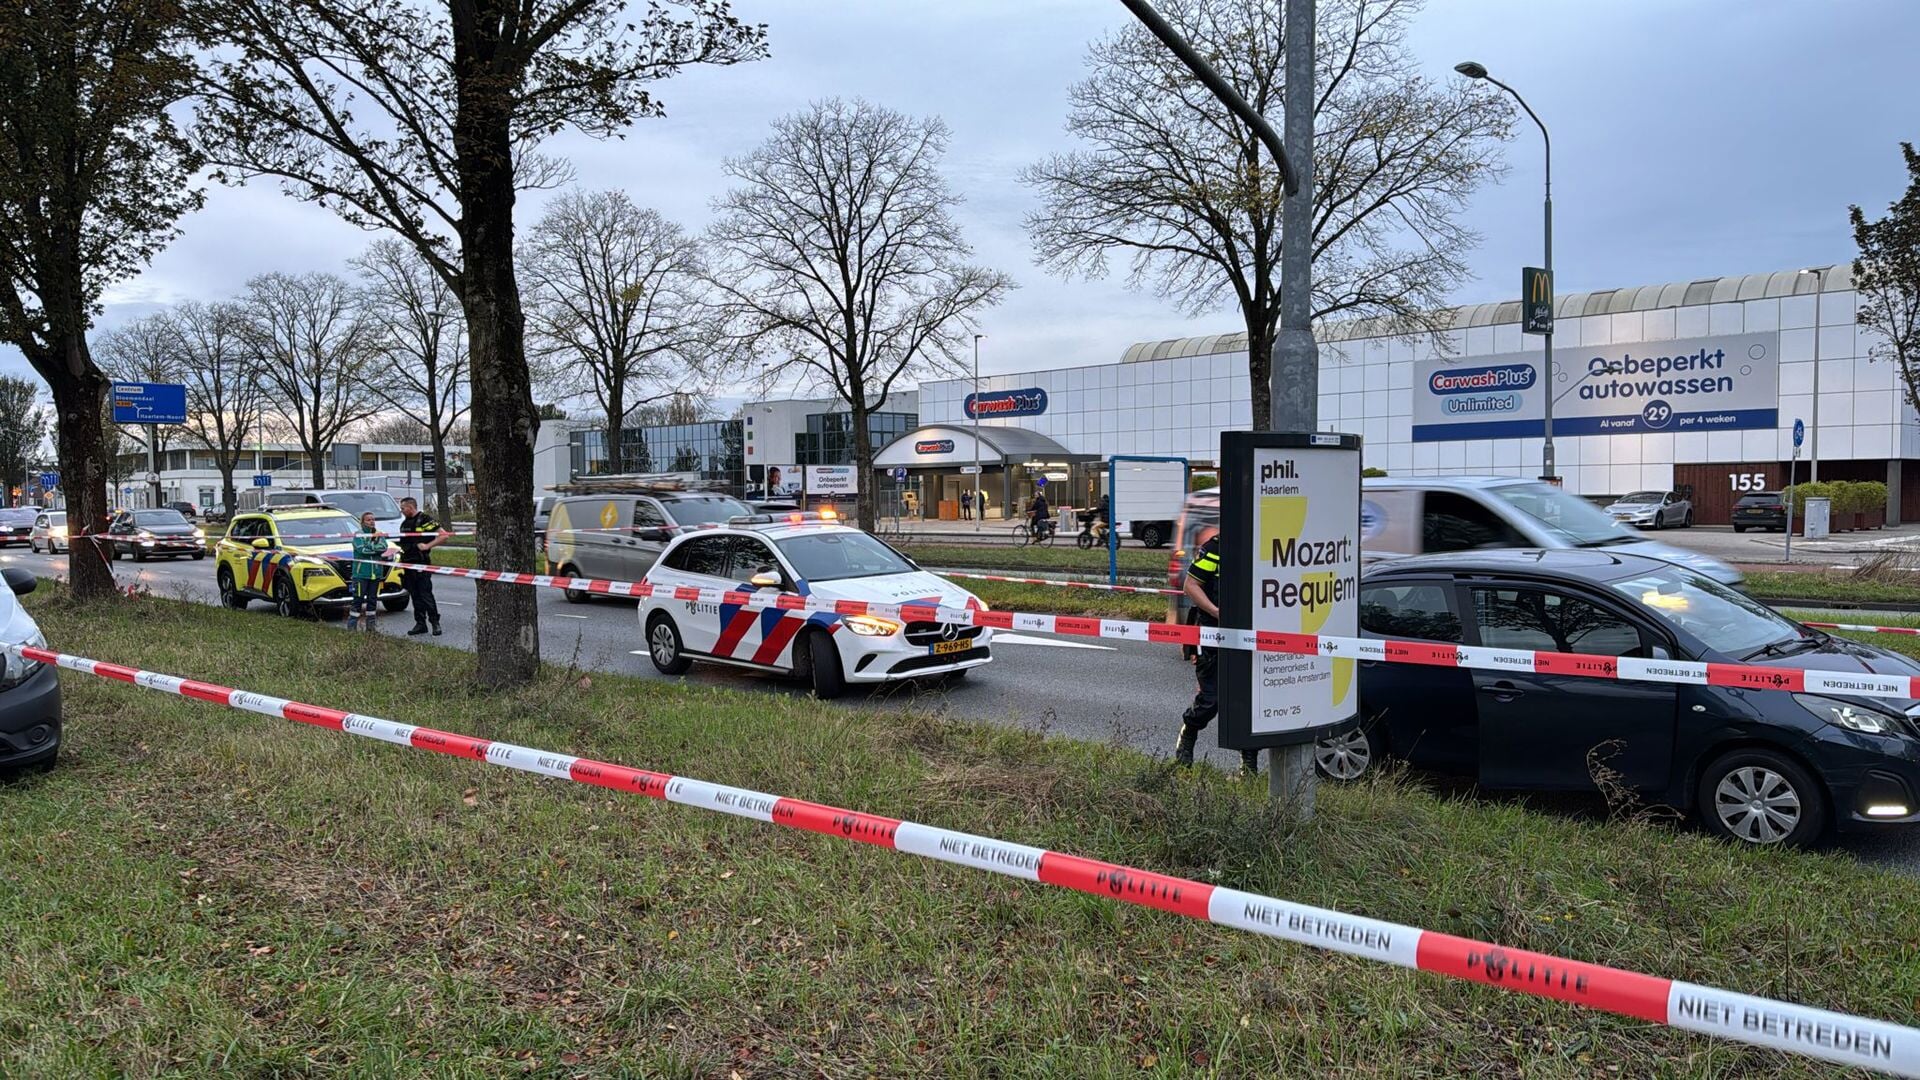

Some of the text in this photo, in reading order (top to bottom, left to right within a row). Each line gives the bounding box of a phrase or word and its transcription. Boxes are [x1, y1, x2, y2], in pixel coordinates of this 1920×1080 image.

[1588, 348, 1725, 378] Onbeperkt
[1433, 368, 1532, 389] CarwashPlus
[1579, 375, 1733, 400] autowassen
[969, 394, 1041, 414] CarwashPlus
[1448, 395, 1515, 413] Unlimited
[1600, 420, 1609, 428] Al
[1611, 418, 1635, 427] vanaf
[1680, 417, 1694, 426] per
[1697, 415, 1703, 424] 4
[1705, 414, 1736, 424] weken
[1261, 460, 1299, 483] phil.
[1261, 485, 1299, 495] Haarlem
[1729, 473, 1766, 491] 155
[1272, 535, 1351, 567] Mozart:
[1261, 571, 1355, 613] Requiem
[936, 640, 969, 653] Z-969-HS
[1263, 663, 1309, 675] Kamerorkest
[1493, 656, 1549, 666] NIET BETREDEN
[1263, 671, 1331, 688] Cappella Amsterdam
[1646, 667, 1711, 679] NIET BETREDEN
[1823, 680, 1899, 692] NIET BETREDEN
[1263, 709, 1272, 718] 12
[1273, 709, 1288, 717] nov
[394, 727, 412, 738] NIET
[537, 756, 602, 778] NIET BETREDEN
[714, 791, 795, 819] NIET BETREDEN
[939, 836, 1043, 871] NIET BETREDEN
[1244, 901, 1392, 951] NIET BETREDEN
[1678, 994, 1893, 1060] NIET BETREDEN
